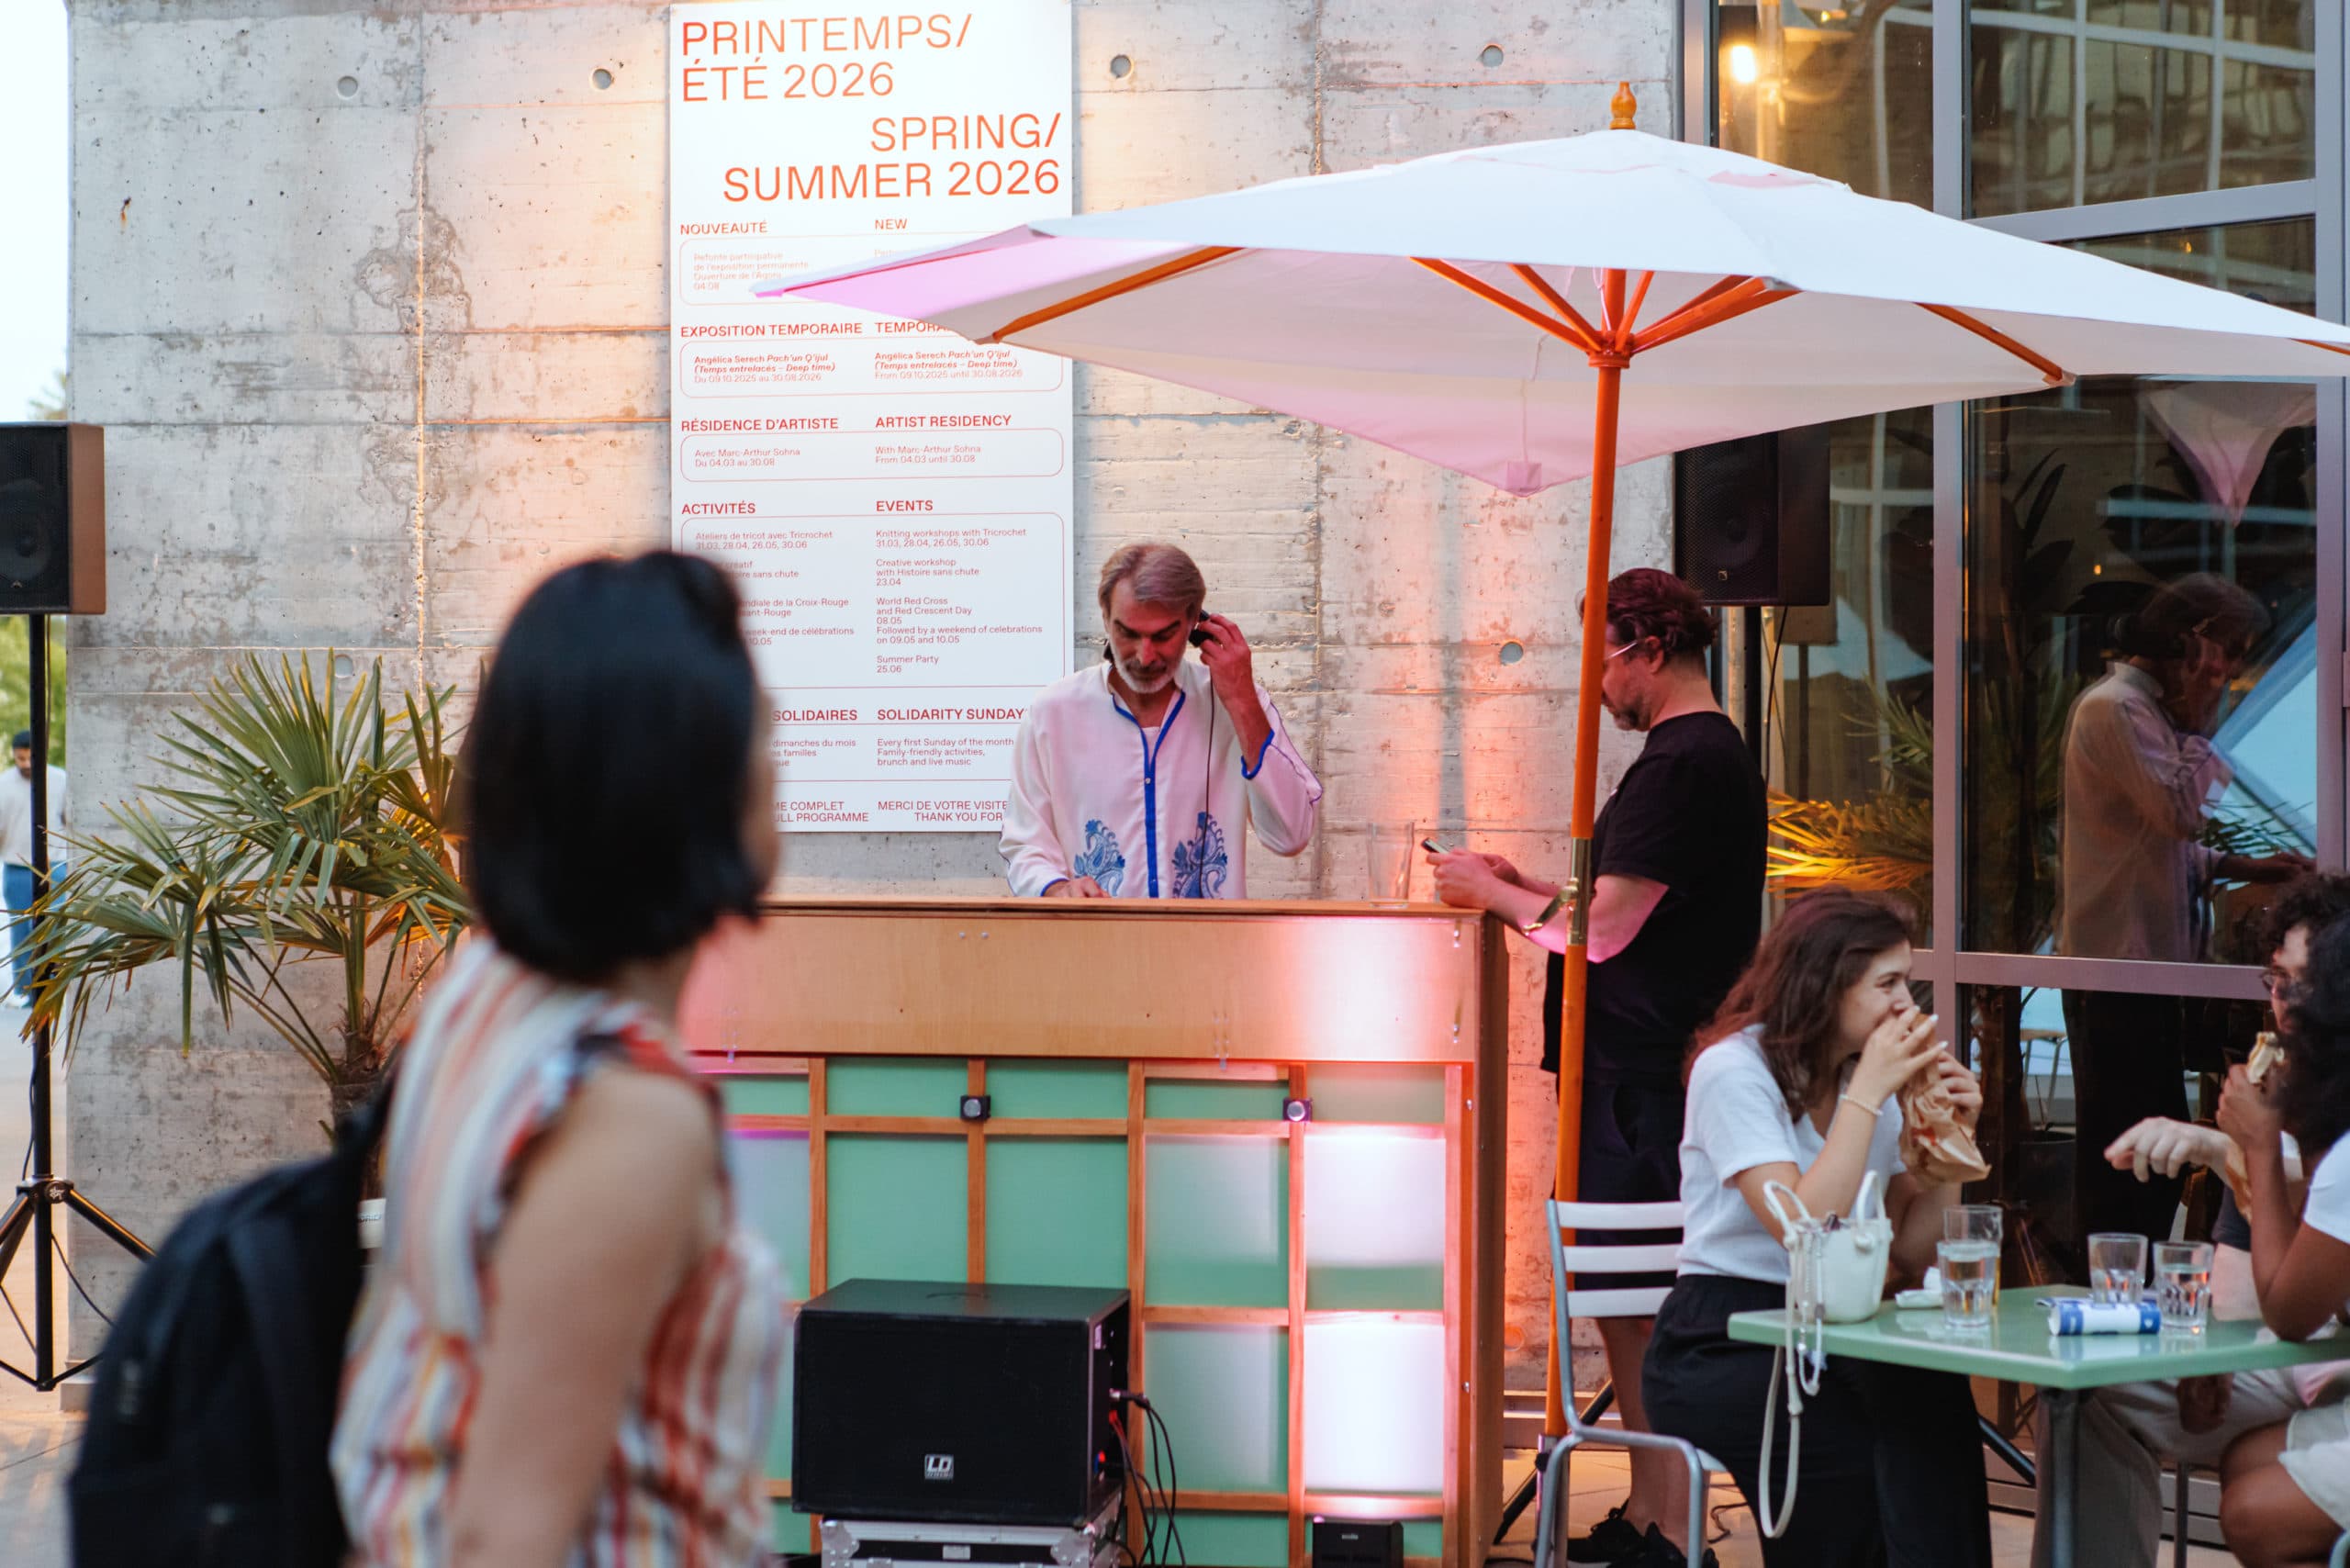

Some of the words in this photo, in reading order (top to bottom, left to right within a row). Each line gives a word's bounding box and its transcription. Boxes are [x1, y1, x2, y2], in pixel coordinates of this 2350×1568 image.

[682, 13, 972, 56] PRINTEMPS/
[682, 57, 768, 102] ÉTÉ
[783, 61, 894, 99] 2026
[870, 112, 1061, 152] SPRING/
[723, 163, 932, 202] SUMMER
[947, 158, 1060, 197] 2026
[679, 220, 767, 236] NOUVEAUTÉ
[874, 218, 908, 230] NEW
[681, 323, 767, 338] EXPOSITION
[769, 322, 863, 336] TEMPORAIRE
[694, 355, 733, 365] Angélica
[734, 355, 766, 364] Serech
[875, 352, 913, 361] Angélica
[915, 352, 946, 360] Serech
[694, 364, 727, 374] (Temps
[787, 364, 809, 373] Deep
[811, 362, 835, 372] time)
[875, 361, 908, 370] (Temps
[968, 360, 990, 368] Deep
[993, 359, 1018, 368] time)
[875, 371, 897, 379] From
[950, 369, 969, 378] until
[695, 375, 707, 384] Du
[681, 418, 762, 431] RÉSIDENCE
[766, 418, 838, 430] D'ARTISTE
[875, 417, 926, 428] ARTIST
[930, 415, 1012, 427] RESIDENCY
[695, 449, 716, 457] Avec
[875, 446, 896, 454] With
[695, 459, 707, 467] Du
[709, 459, 735, 467] 04.03
[750, 458, 776, 466] 30.08
[875, 455, 898, 464] From
[901, 454, 926, 464] 04.03
[929, 454, 948, 463] until
[681, 501, 756, 515] ACTIVITÉS
[876, 499, 934, 512] EVENTS
[696, 532, 728, 540] Ateliers
[730, 532, 741, 540] de
[789, 531, 833, 539] Tricrochet
[876, 529, 911, 539] Knitting
[912, 529, 959, 538] workshops
[961, 528, 980, 537] with
[983, 528, 1026, 536] Tricrochet
[722, 542, 750, 550] 28.04,
[752, 542, 779, 550] 26.05,
[781, 541, 808, 549] 30.06
[876, 539, 901, 548] 31.03,
[903, 538, 930, 548] 28.04,
[933, 538, 961, 547] 26.05,
[963, 538, 989, 547] 30.06
[876, 558, 912, 567] Creative
[913, 558, 957, 567] workshop
[876, 568, 895, 577] with
[897, 567, 931, 577] Histoire
[955, 567, 979, 576] chute
[876, 578, 901, 587] 23.04
[795, 598, 849, 608] Croix-Rouge
[923, 597, 948, 605] Cross
[955, 606, 972, 616] Day
[801, 627, 855, 635] célébrations
[877, 626, 915, 634] Followed
[918, 626, 928, 635] by
[979, 625, 987, 633] of
[989, 625, 1043, 633] celebrations
[936, 635, 960, 644] 10.05
[915, 655, 939, 665] Party
[877, 665, 902, 673] 25.06
[773, 710, 857, 722] SOLIDAIRES
[878, 709, 963, 721] SOLIDARITY
[878, 739, 901, 747] Every
[903, 738, 921, 746] first
[923, 738, 956, 747] Sunday
[969, 737, 982, 745] the
[877, 747, 942, 757] Family-friendly
[911, 757, 926, 766] and
[929, 757, 943, 766] live
[946, 757, 971, 766] music
[789, 801, 845, 811] COMPLET
[878, 801, 913, 811] MERCI
[917, 801, 931, 811] DE
[934, 801, 971, 810] VOTRE
[797, 812, 869, 823] PROGRAMME
[914, 812, 953, 822] THANK
[956, 812, 977, 822] YOU
[981, 812, 1002, 821] FOR
